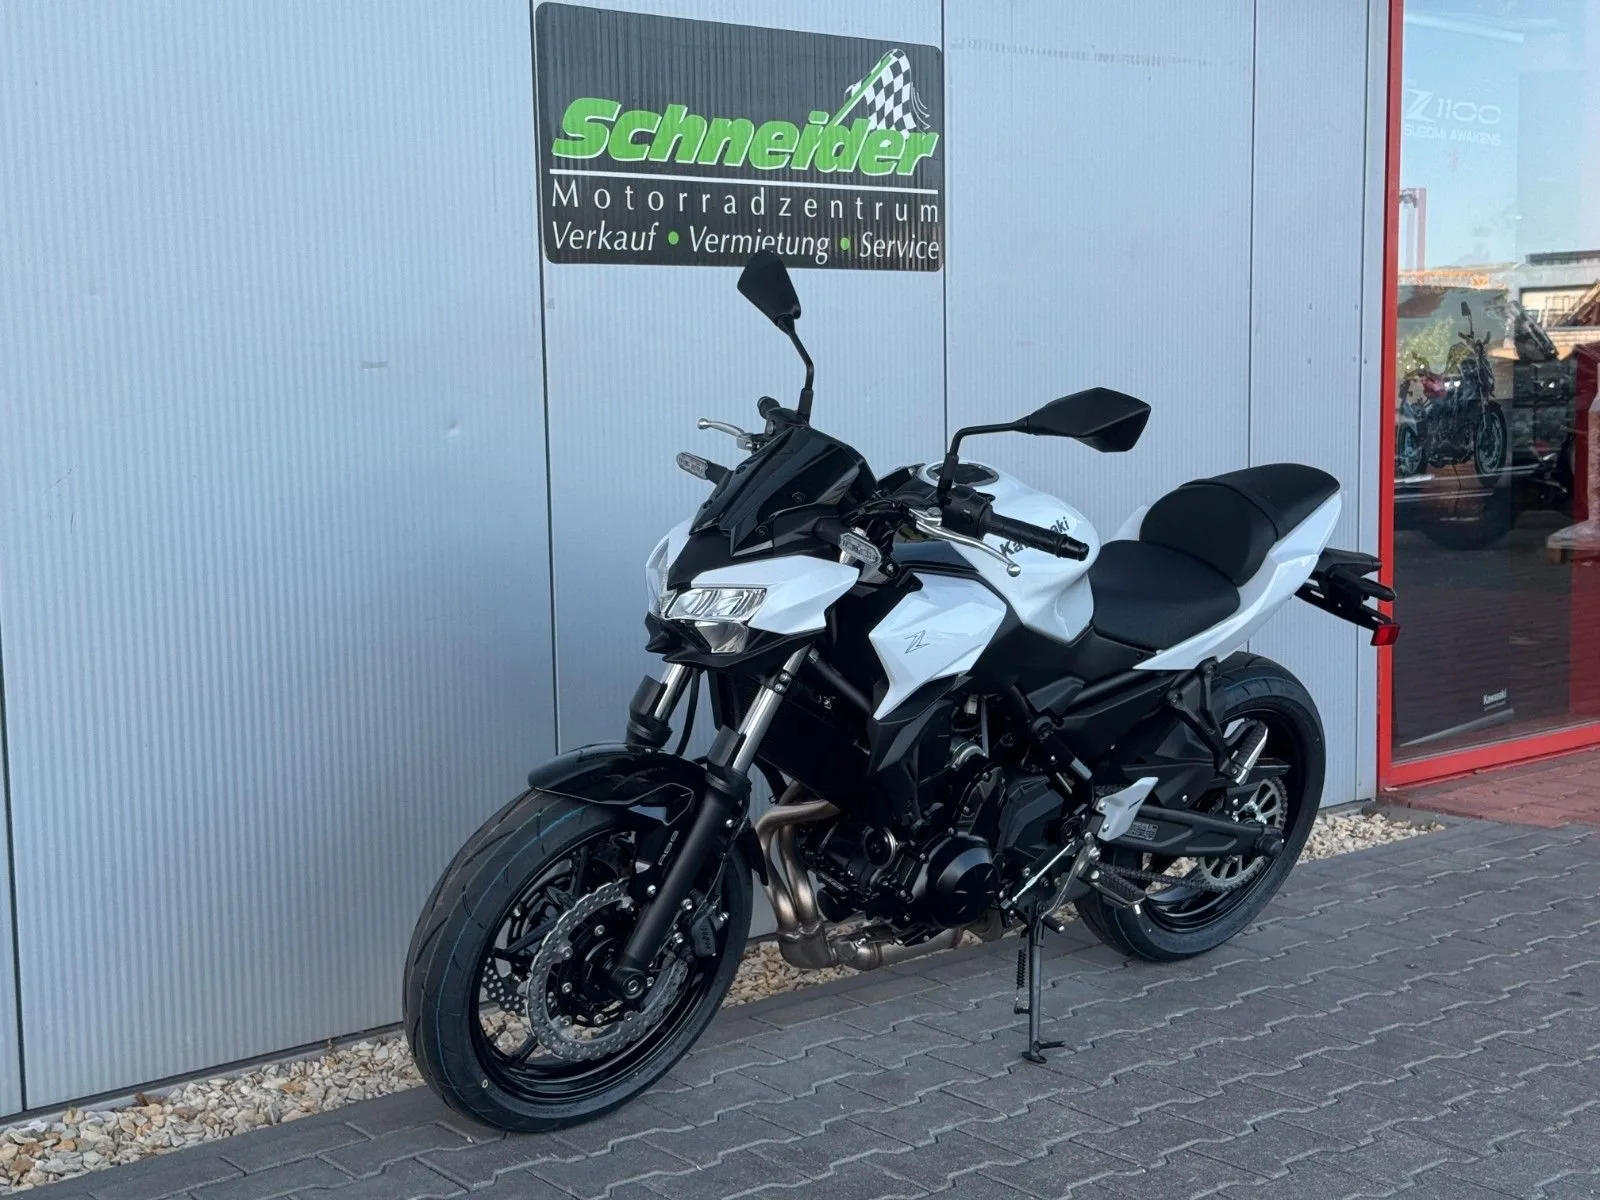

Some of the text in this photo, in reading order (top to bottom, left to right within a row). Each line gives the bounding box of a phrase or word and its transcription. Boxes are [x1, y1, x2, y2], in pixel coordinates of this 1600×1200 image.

[551, 97, 940, 177] Schneider
[1450, 128, 1502, 146] AWAKENS
[551, 178, 939, 223] Motorradzentrum
[551, 220, 940, 265] Verkauf Vermietung Service
[999, 516, 1070, 558] Kaaki
